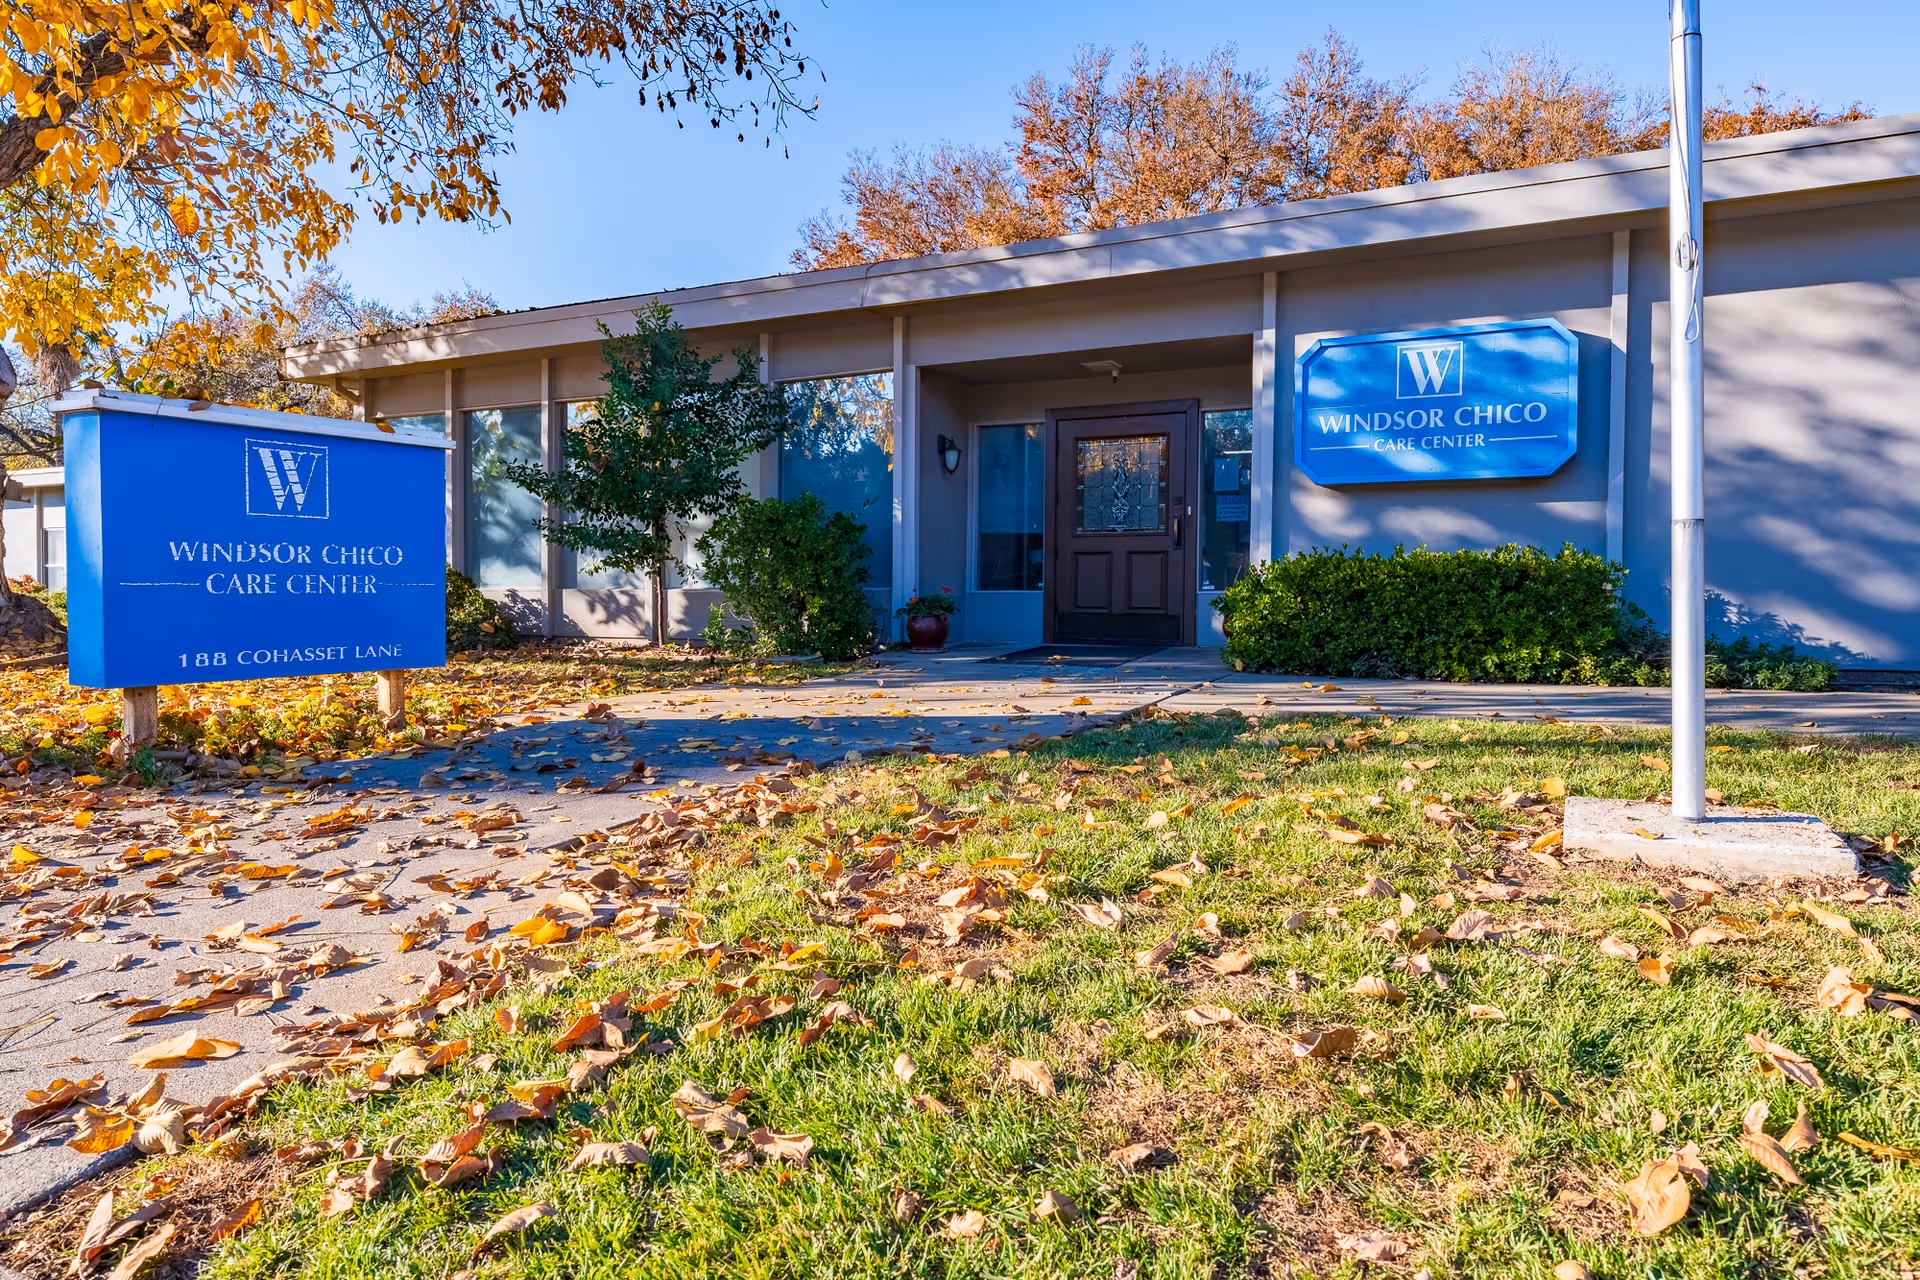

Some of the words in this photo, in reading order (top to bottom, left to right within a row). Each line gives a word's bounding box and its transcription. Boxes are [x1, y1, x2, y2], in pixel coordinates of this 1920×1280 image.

[1402, 346, 1458, 394] W
[1318, 408, 1445, 434] WINDSOR
[1454, 402, 1547, 426] CHICO
[1374, 438, 1415, 452] CARE
[1421, 433, 1485, 450] CENTER
[252, 446, 323, 512] W
[169, 541, 312, 565] WINDSOR
[322, 543, 403, 566] CHICO
[206, 572, 277, 595] CARE
[286, 574, 377, 595] CENTER
[178, 652, 227, 668] 188
[237, 646, 347, 665] COHASSET
[355, 644, 402, 659] LANE
